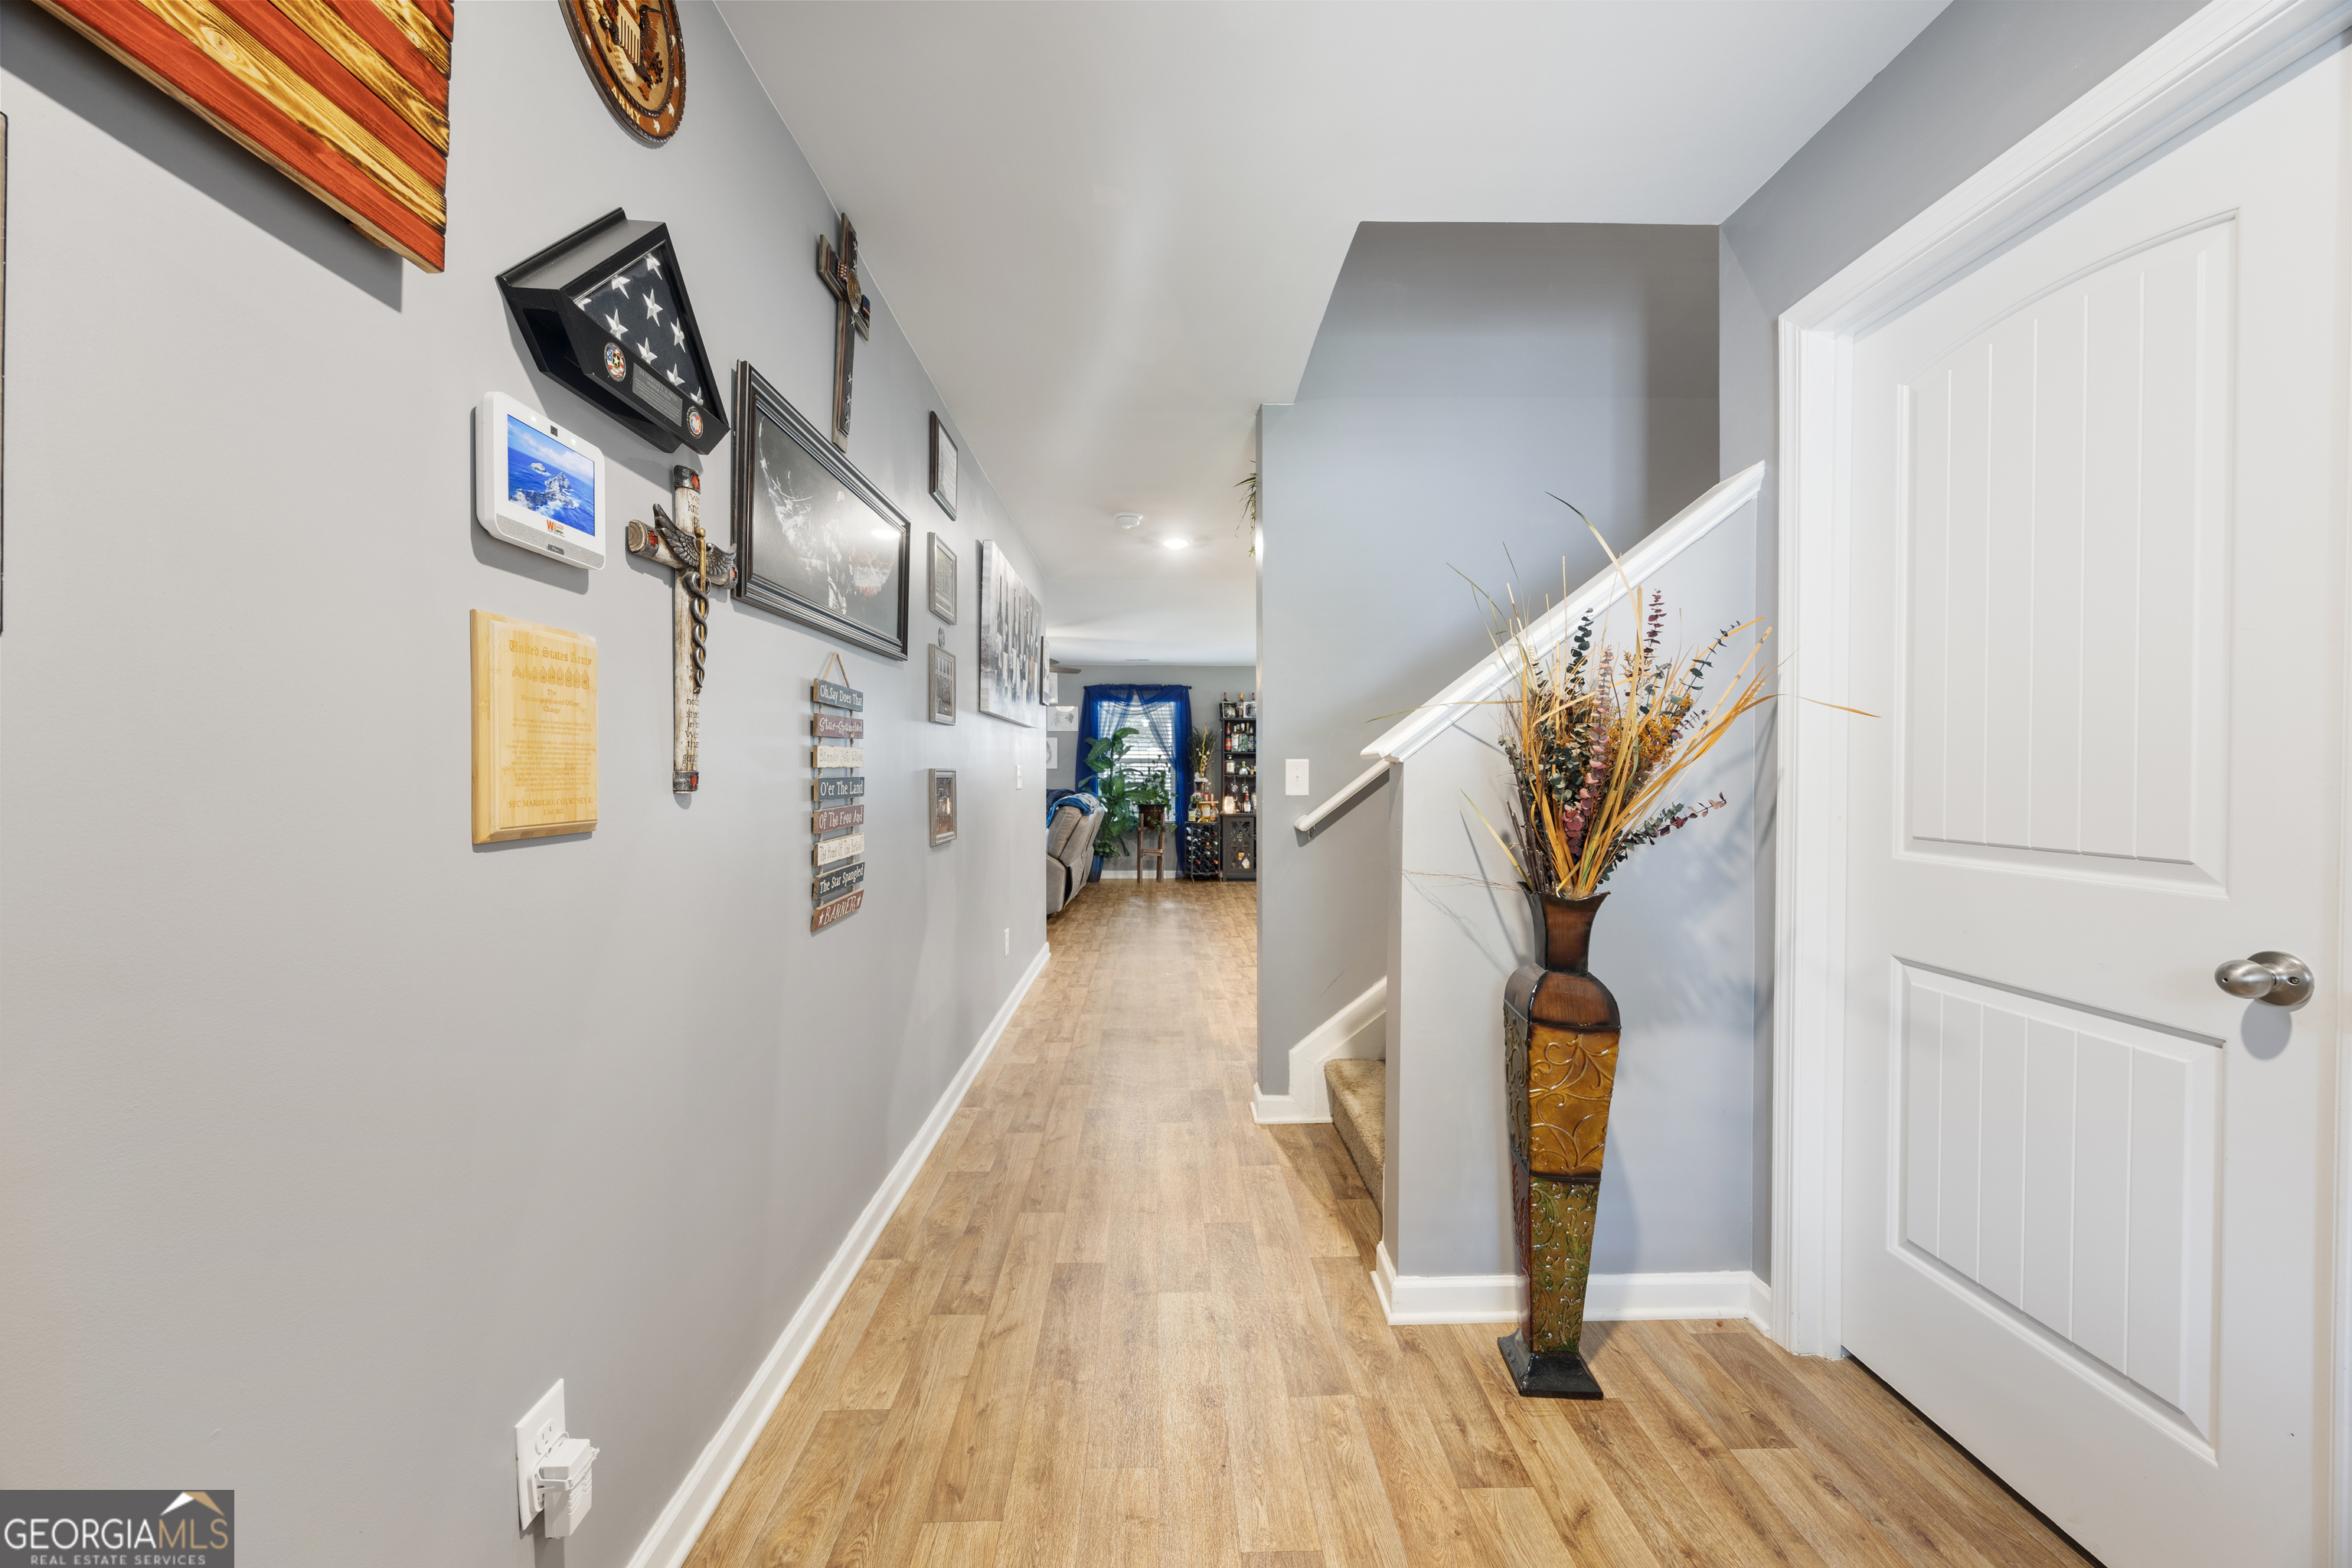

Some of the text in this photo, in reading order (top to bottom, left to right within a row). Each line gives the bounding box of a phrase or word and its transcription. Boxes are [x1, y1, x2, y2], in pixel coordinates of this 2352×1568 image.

[611, 86, 641, 125] ARMY
[508, 639, 592, 668] United States Army
[521, 694, 580, 707] Noncommissioned Officer
[839, 690, 852, 704] Does
[852, 693, 863, 706] That
[543, 705, 560, 714] Charge
[819, 717, 863, 737] Star-Spangled
[819, 749, 838, 763] Banner
[840, 750, 850, 766] Yet
[820, 780, 863, 796] O'er The Land
[508, 800, 522, 808] SFC
[523, 799, 555, 808] MARRUJO,
[556, 797, 587, 805] COURTNEY
[819, 806, 863, 829] Of The Free And
[828, 844, 837, 859] Home
[838, 840, 843, 857] Of
[820, 864, 864, 894] The Star Spangled
[823, 895, 857, 925] BANNER
